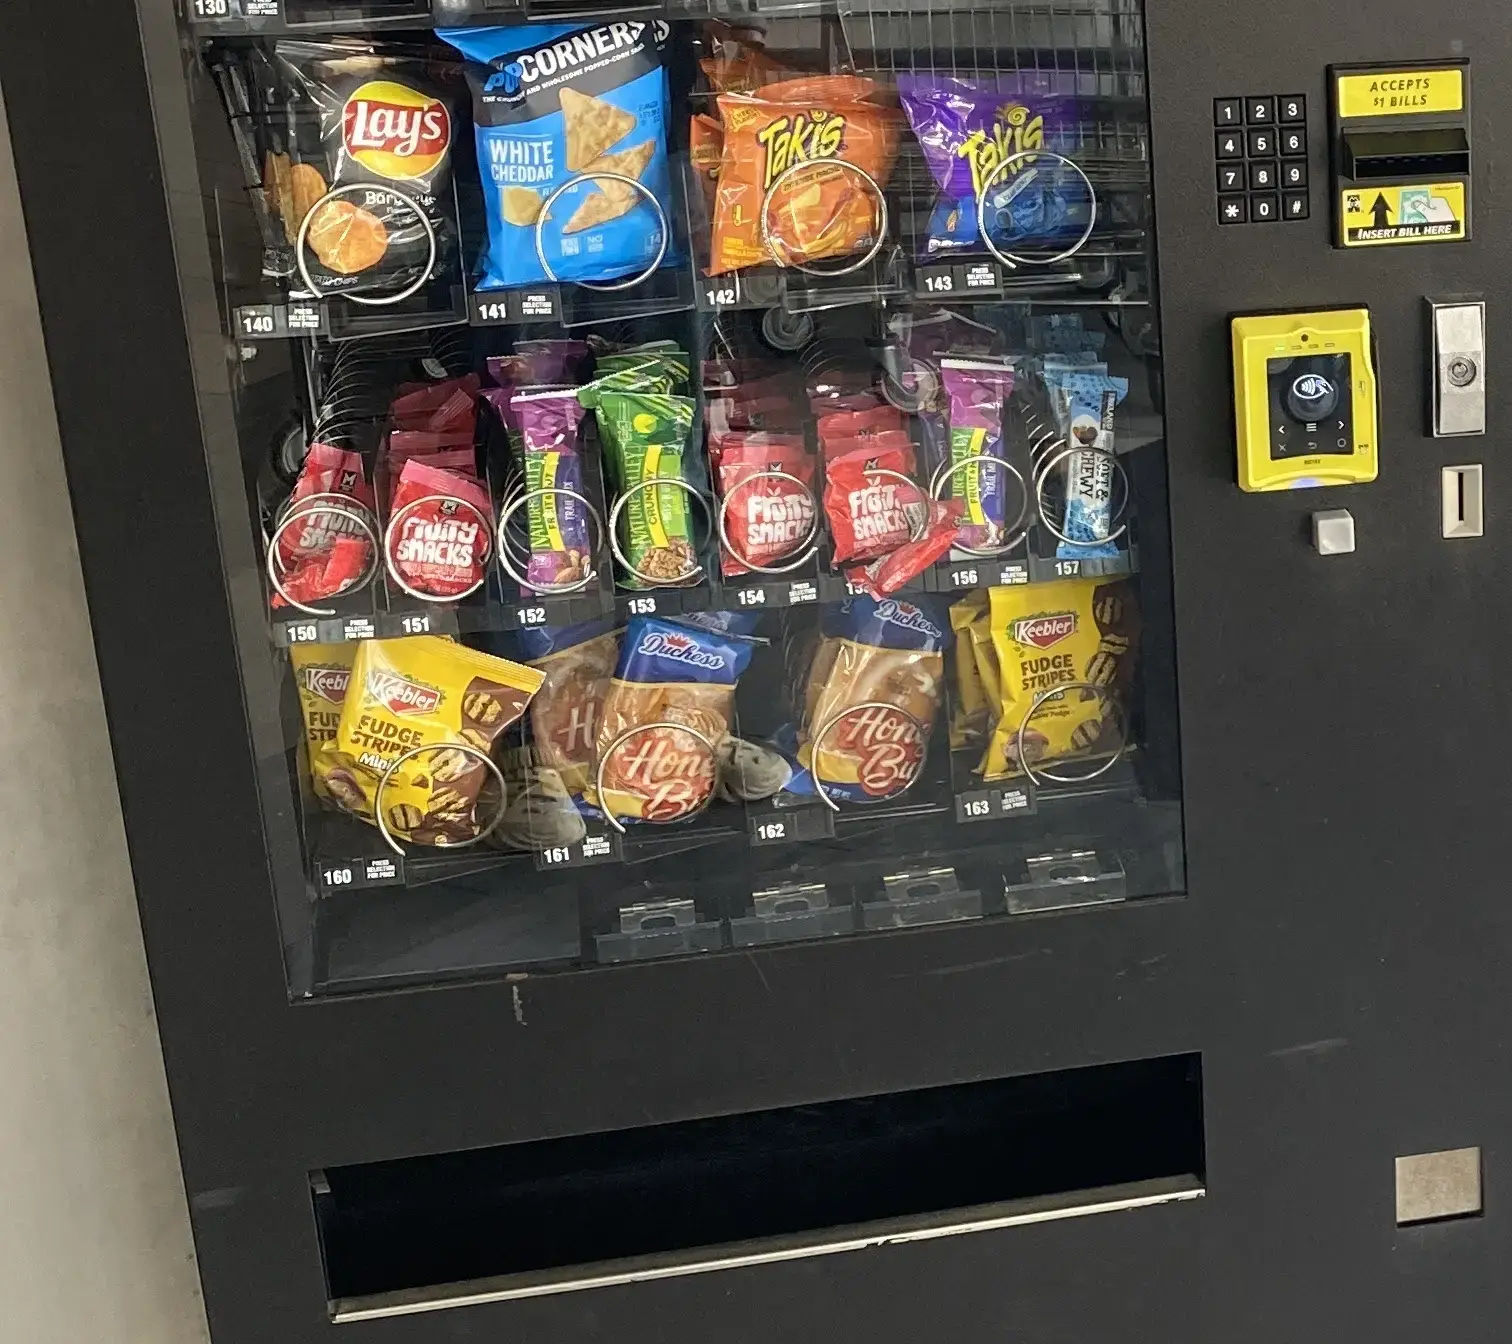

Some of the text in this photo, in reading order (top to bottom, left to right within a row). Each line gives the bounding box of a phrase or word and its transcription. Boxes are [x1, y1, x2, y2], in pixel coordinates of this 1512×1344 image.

[1369, 78, 1431, 93] ACCEPTS
[1373, 94, 1428, 108] $1 BILLS
[1224, 106, 1232, 120] 1
[1255, 105, 1266, 119] 2
[1287, 103, 1298, 117] 3
[351, 101, 442, 156] Lay's
[1224, 139, 1235, 153] 4
[1257, 137, 1267, 151] 5
[1289, 135, 1299, 149] 6
[490, 139, 554, 165] WHITE
[491, 164, 554, 183] CHEDDAR
[1225, 172, 1236, 186] 7
[1258, 170, 1268, 184] 8
[1290, 168, 1300, 182] 9
[1259, 202, 1269, 217] 0
[1357, 223, 1452, 241] INSERT BILL HERE
[925, 276, 952, 292] 143
[706, 290, 736, 306] 142
[479, 303, 507, 320] 141
[242, 317, 274, 333] 140
[643, 469, 659, 525] CRUNCHY
[402, 514, 479, 545] FRUITY
[396, 538, 474, 567] SMACKS
[1055, 561, 1080, 576] 157
[952, 570, 978, 586] 156
[738, 589, 766, 605] 154
[628, 598, 656, 614] 153
[517, 608, 546, 624] 152
[402, 617, 430, 633] 151
[1017, 619, 1072, 643] Keebler
[288, 625, 317, 642] 150
[638, 630, 726, 671] Duchess
[1020, 653, 1074, 677] FUDGE
[1021, 668, 1077, 692] STRIPES
[372, 674, 436, 710] Keebler
[358, 714, 424, 749] FUDGE
[964, 800, 990, 816] 163
[757, 823, 785, 840] 162
[543, 847, 570, 863] 161
[323, 868, 352, 885] 160
